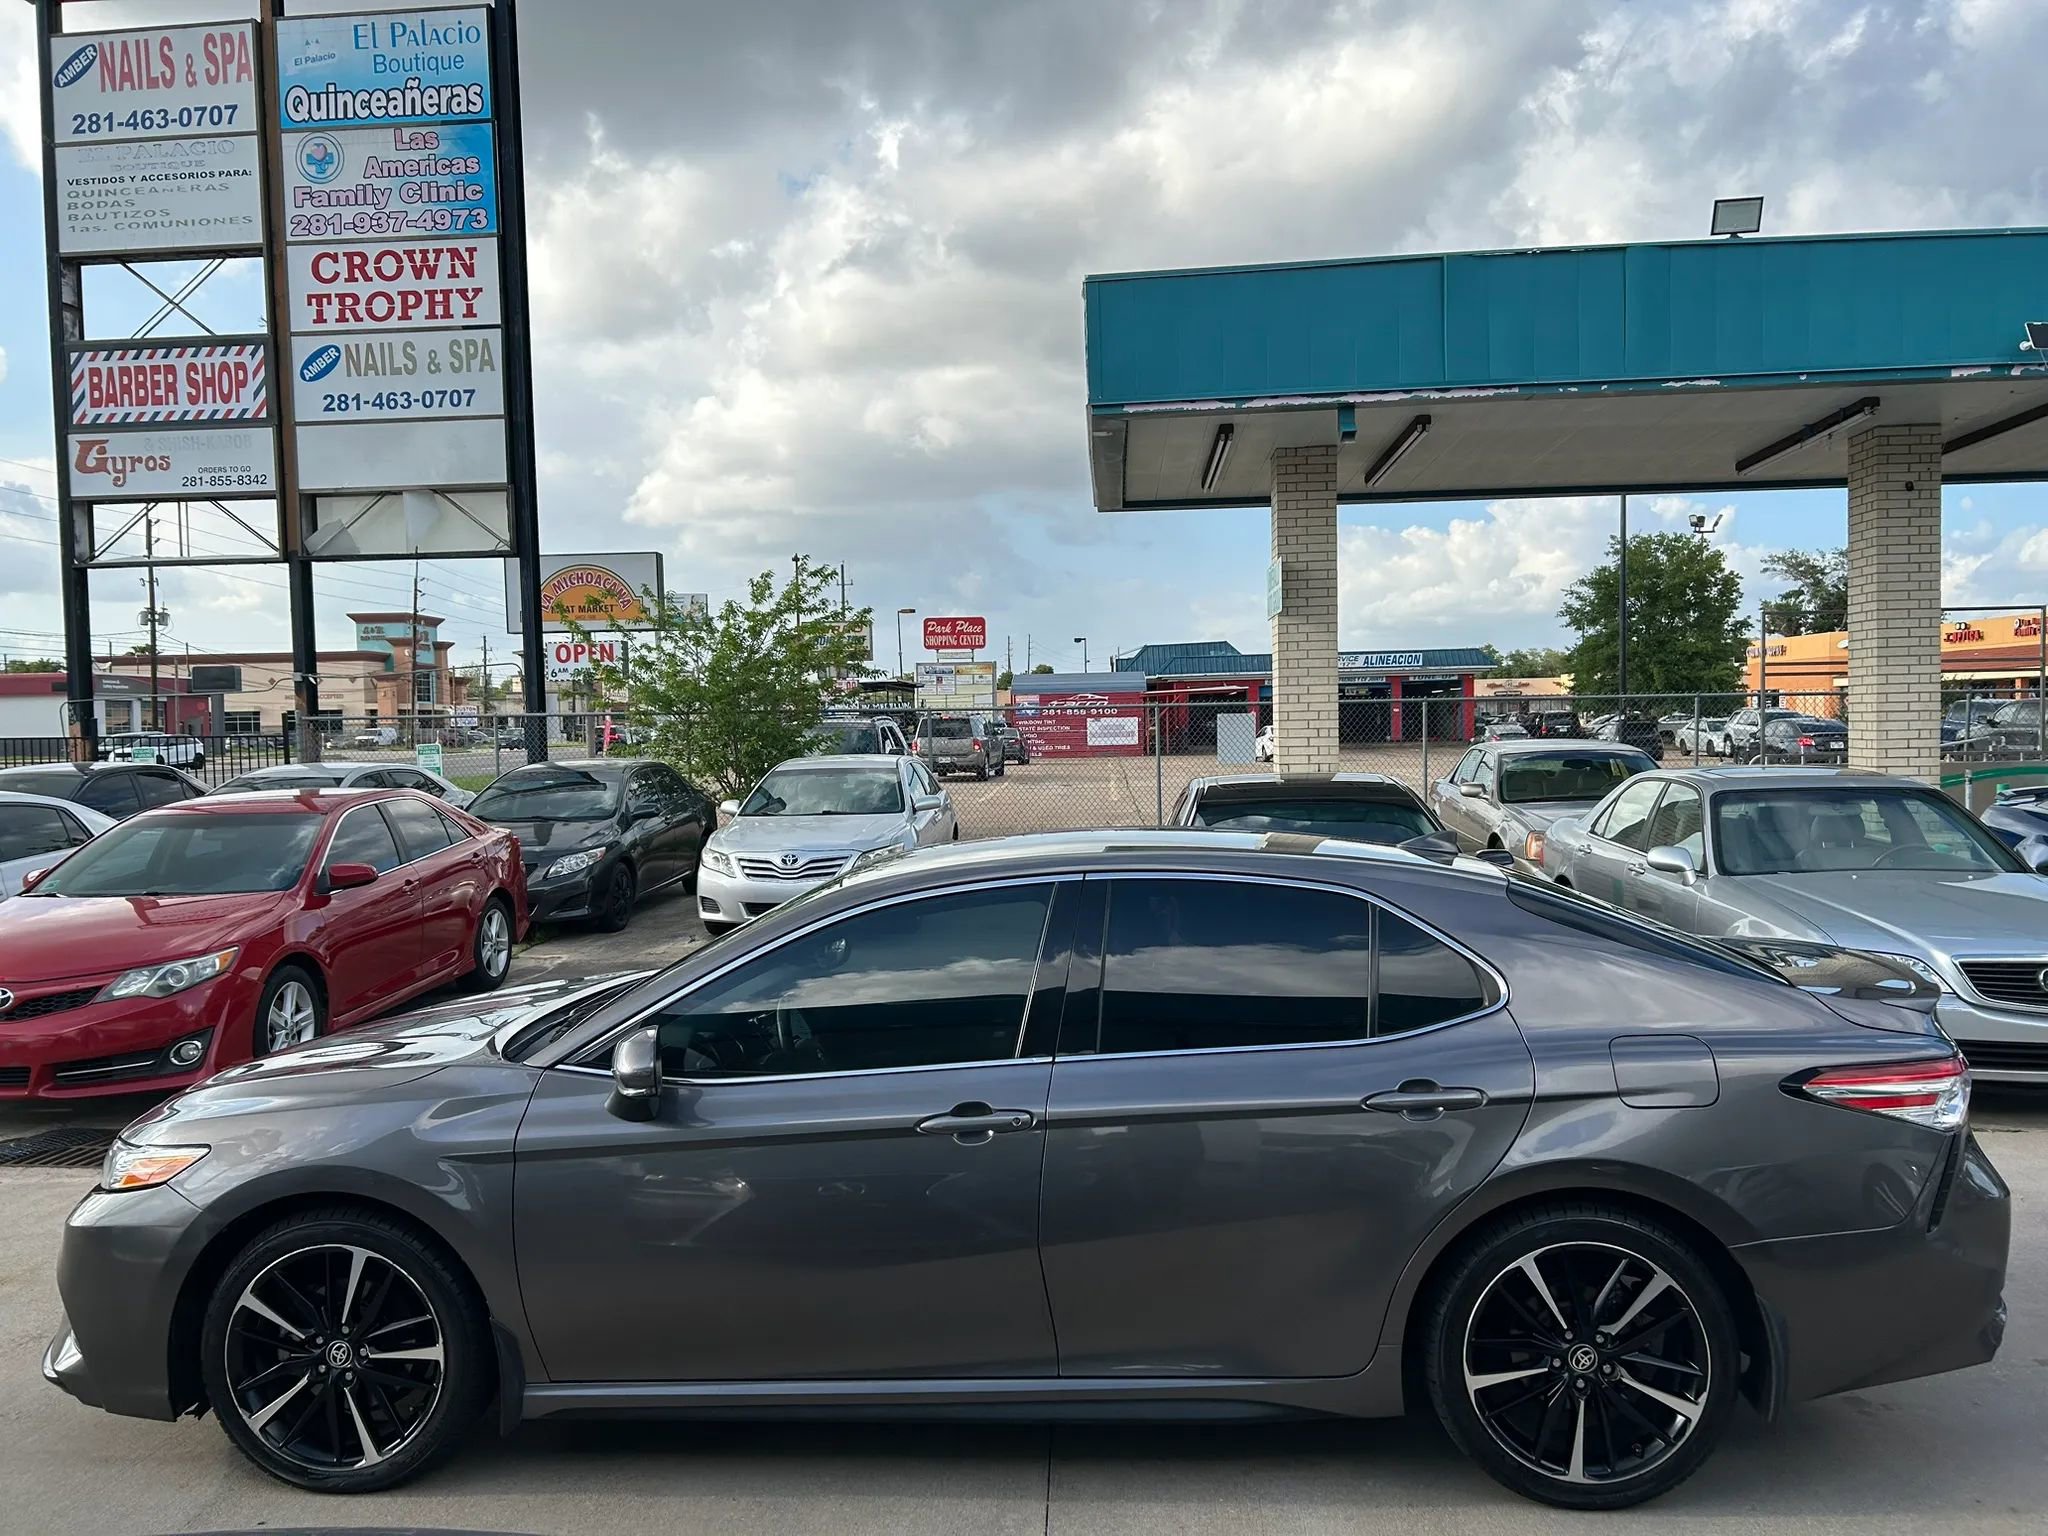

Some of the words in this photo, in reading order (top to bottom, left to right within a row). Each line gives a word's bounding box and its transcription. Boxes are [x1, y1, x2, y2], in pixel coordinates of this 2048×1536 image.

[353, 22, 379, 50] El
[56, 46, 98, 87] AMBER
[98, 36, 176, 93] NAILS
[185, 52, 198, 89] &
[203, 31, 254, 86] SPA
[294, 57, 303, 66] El
[304, 52, 336, 65] Palacio
[373, 52, 465, 76] Boutique
[285, 77, 484, 123] Quinceañeras
[71, 104, 238, 135] 281-463-0707
[394, 127, 440, 151] Las
[66, 176, 126, 187] VESTIDOS
[129, 175, 137, 183] Y
[140, 170, 216, 183] ACCESORIOS
[218, 168, 252, 178] PARA:
[363, 154, 481, 179] Americas
[66, 198, 137, 212] BODAS
[293, 183, 393, 210] Family
[399, 180, 484, 204] Clinic
[67, 208, 171, 222] BAUTIZOS
[114, 215, 254, 232] COMUNIONES
[289, 208, 490, 237] 281-937-4973
[310, 246, 478, 285] CROWN
[306, 287, 484, 325] TROPHY
[302, 346, 341, 382] AMBER
[343, 340, 418, 378] NAILS
[427, 348, 442, 375] &
[449, 337, 496, 375] SPA
[88, 364, 180, 409] BARBER
[185, 360, 249, 406] SHOP
[322, 389, 476, 412] 281-463-0707
[74, 438, 172, 488] Gyros
[197, 466, 228, 474] ORDERS
[240, 465, 251, 473] GO
[181, 474, 268, 488] 281-855-8342
[552, 571, 633, 611] MICHOACANA
[551, 605, 575, 615] MAT
[578, 604, 614, 614] MARKET
[926, 621, 952, 634] Park
[955, 620, 983, 634] Place
[925, 634, 958, 647] SHOPPING
[959, 634, 985, 646] CENTER
[555, 643, 615, 664] OPEN
[1362, 654, 1422, 666] ALINEACION
